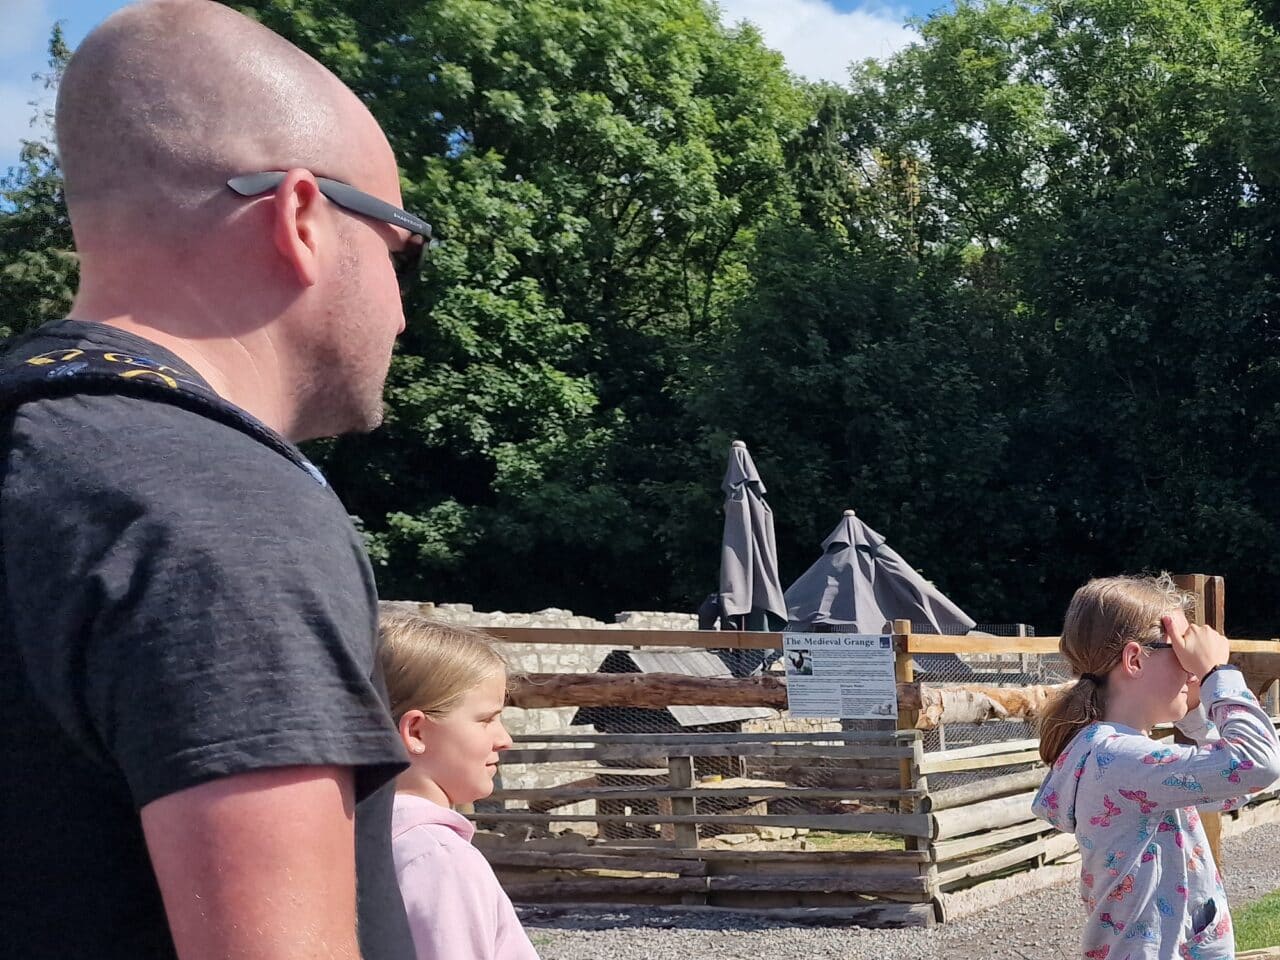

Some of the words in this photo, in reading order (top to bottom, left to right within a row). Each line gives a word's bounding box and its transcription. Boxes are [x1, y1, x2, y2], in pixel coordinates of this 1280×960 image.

[786, 637, 801, 645] The
[804, 637, 841, 646] Medieval
[844, 637, 875, 647] Grange
